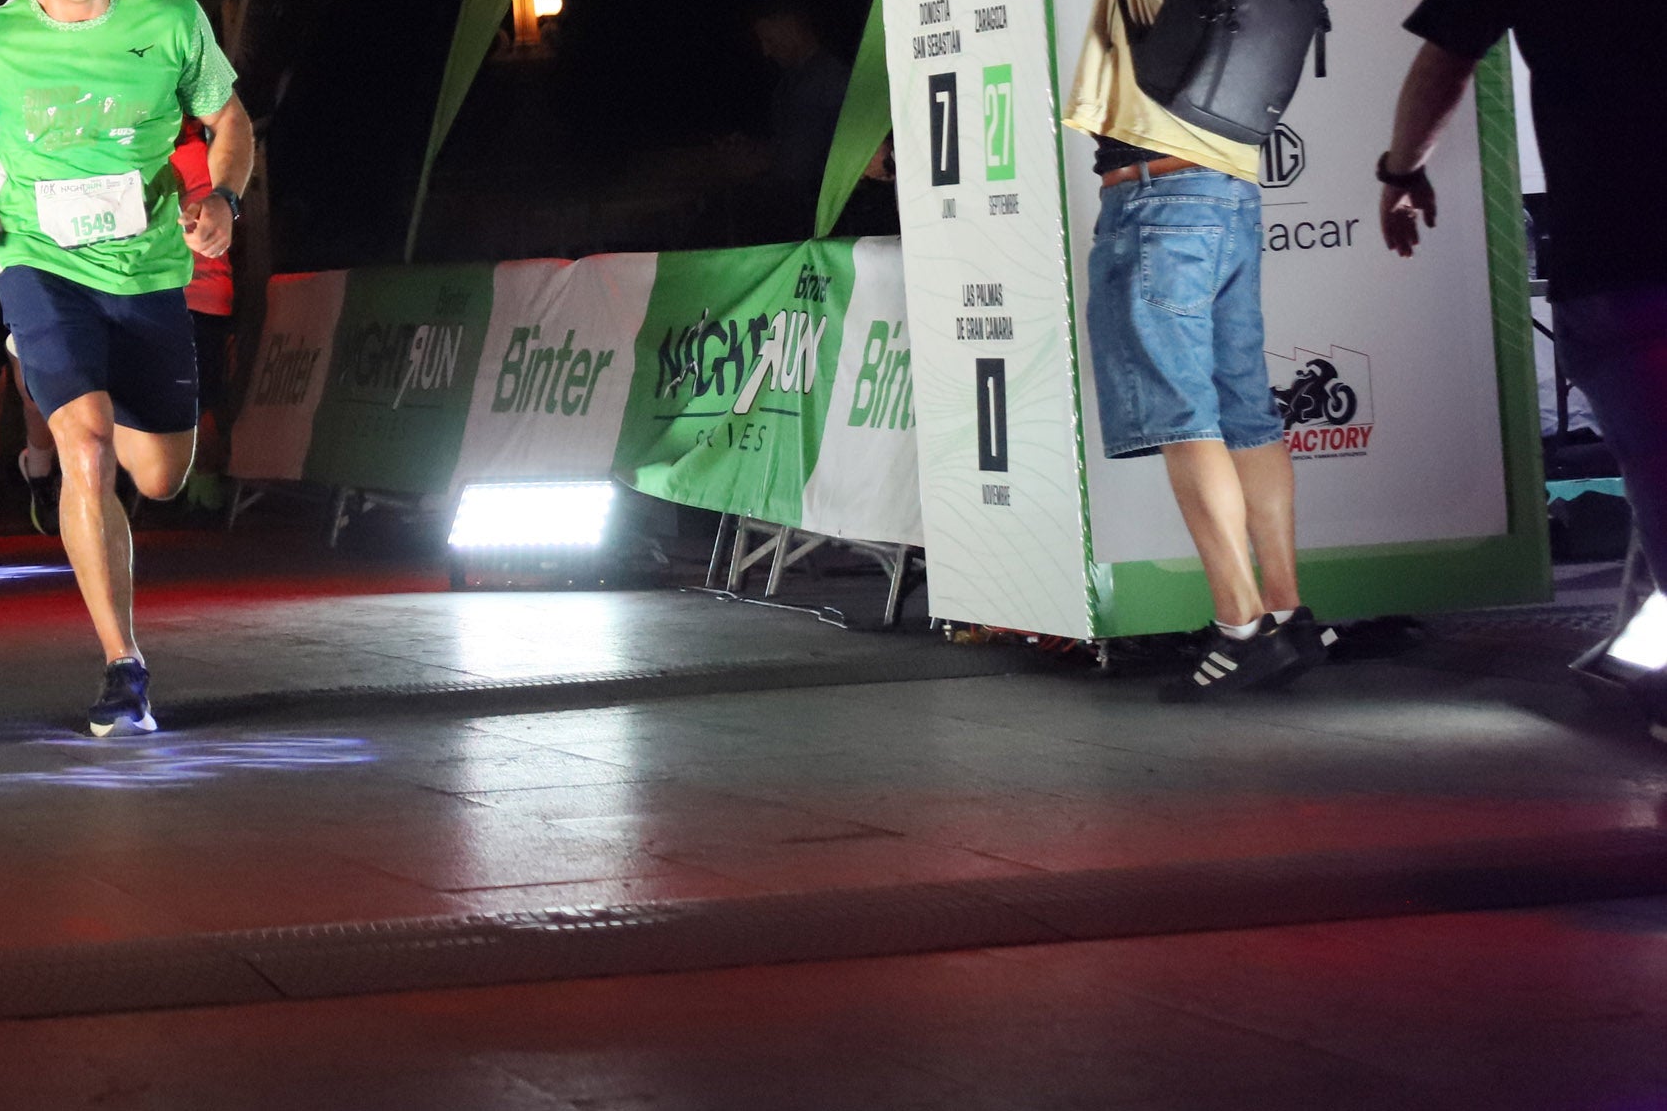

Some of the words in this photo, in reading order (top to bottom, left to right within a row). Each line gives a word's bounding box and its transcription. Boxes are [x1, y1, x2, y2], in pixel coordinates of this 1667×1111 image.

[974, 5, 1008, 33] ZARAGOZA
[936, 91, 950, 172] 7
[984, 82, 1012, 168] 27
[70, 210, 117, 238] 1549
[1262, 217, 1360, 252] acar
[794, 264, 832, 303] Binter
[962, 283, 975, 308] LAS
[976, 283, 1003, 307] PALMAS
[956, 317, 965, 340] DE
[491, 324, 615, 417] Binter
[846, 319, 916, 432] Bin
